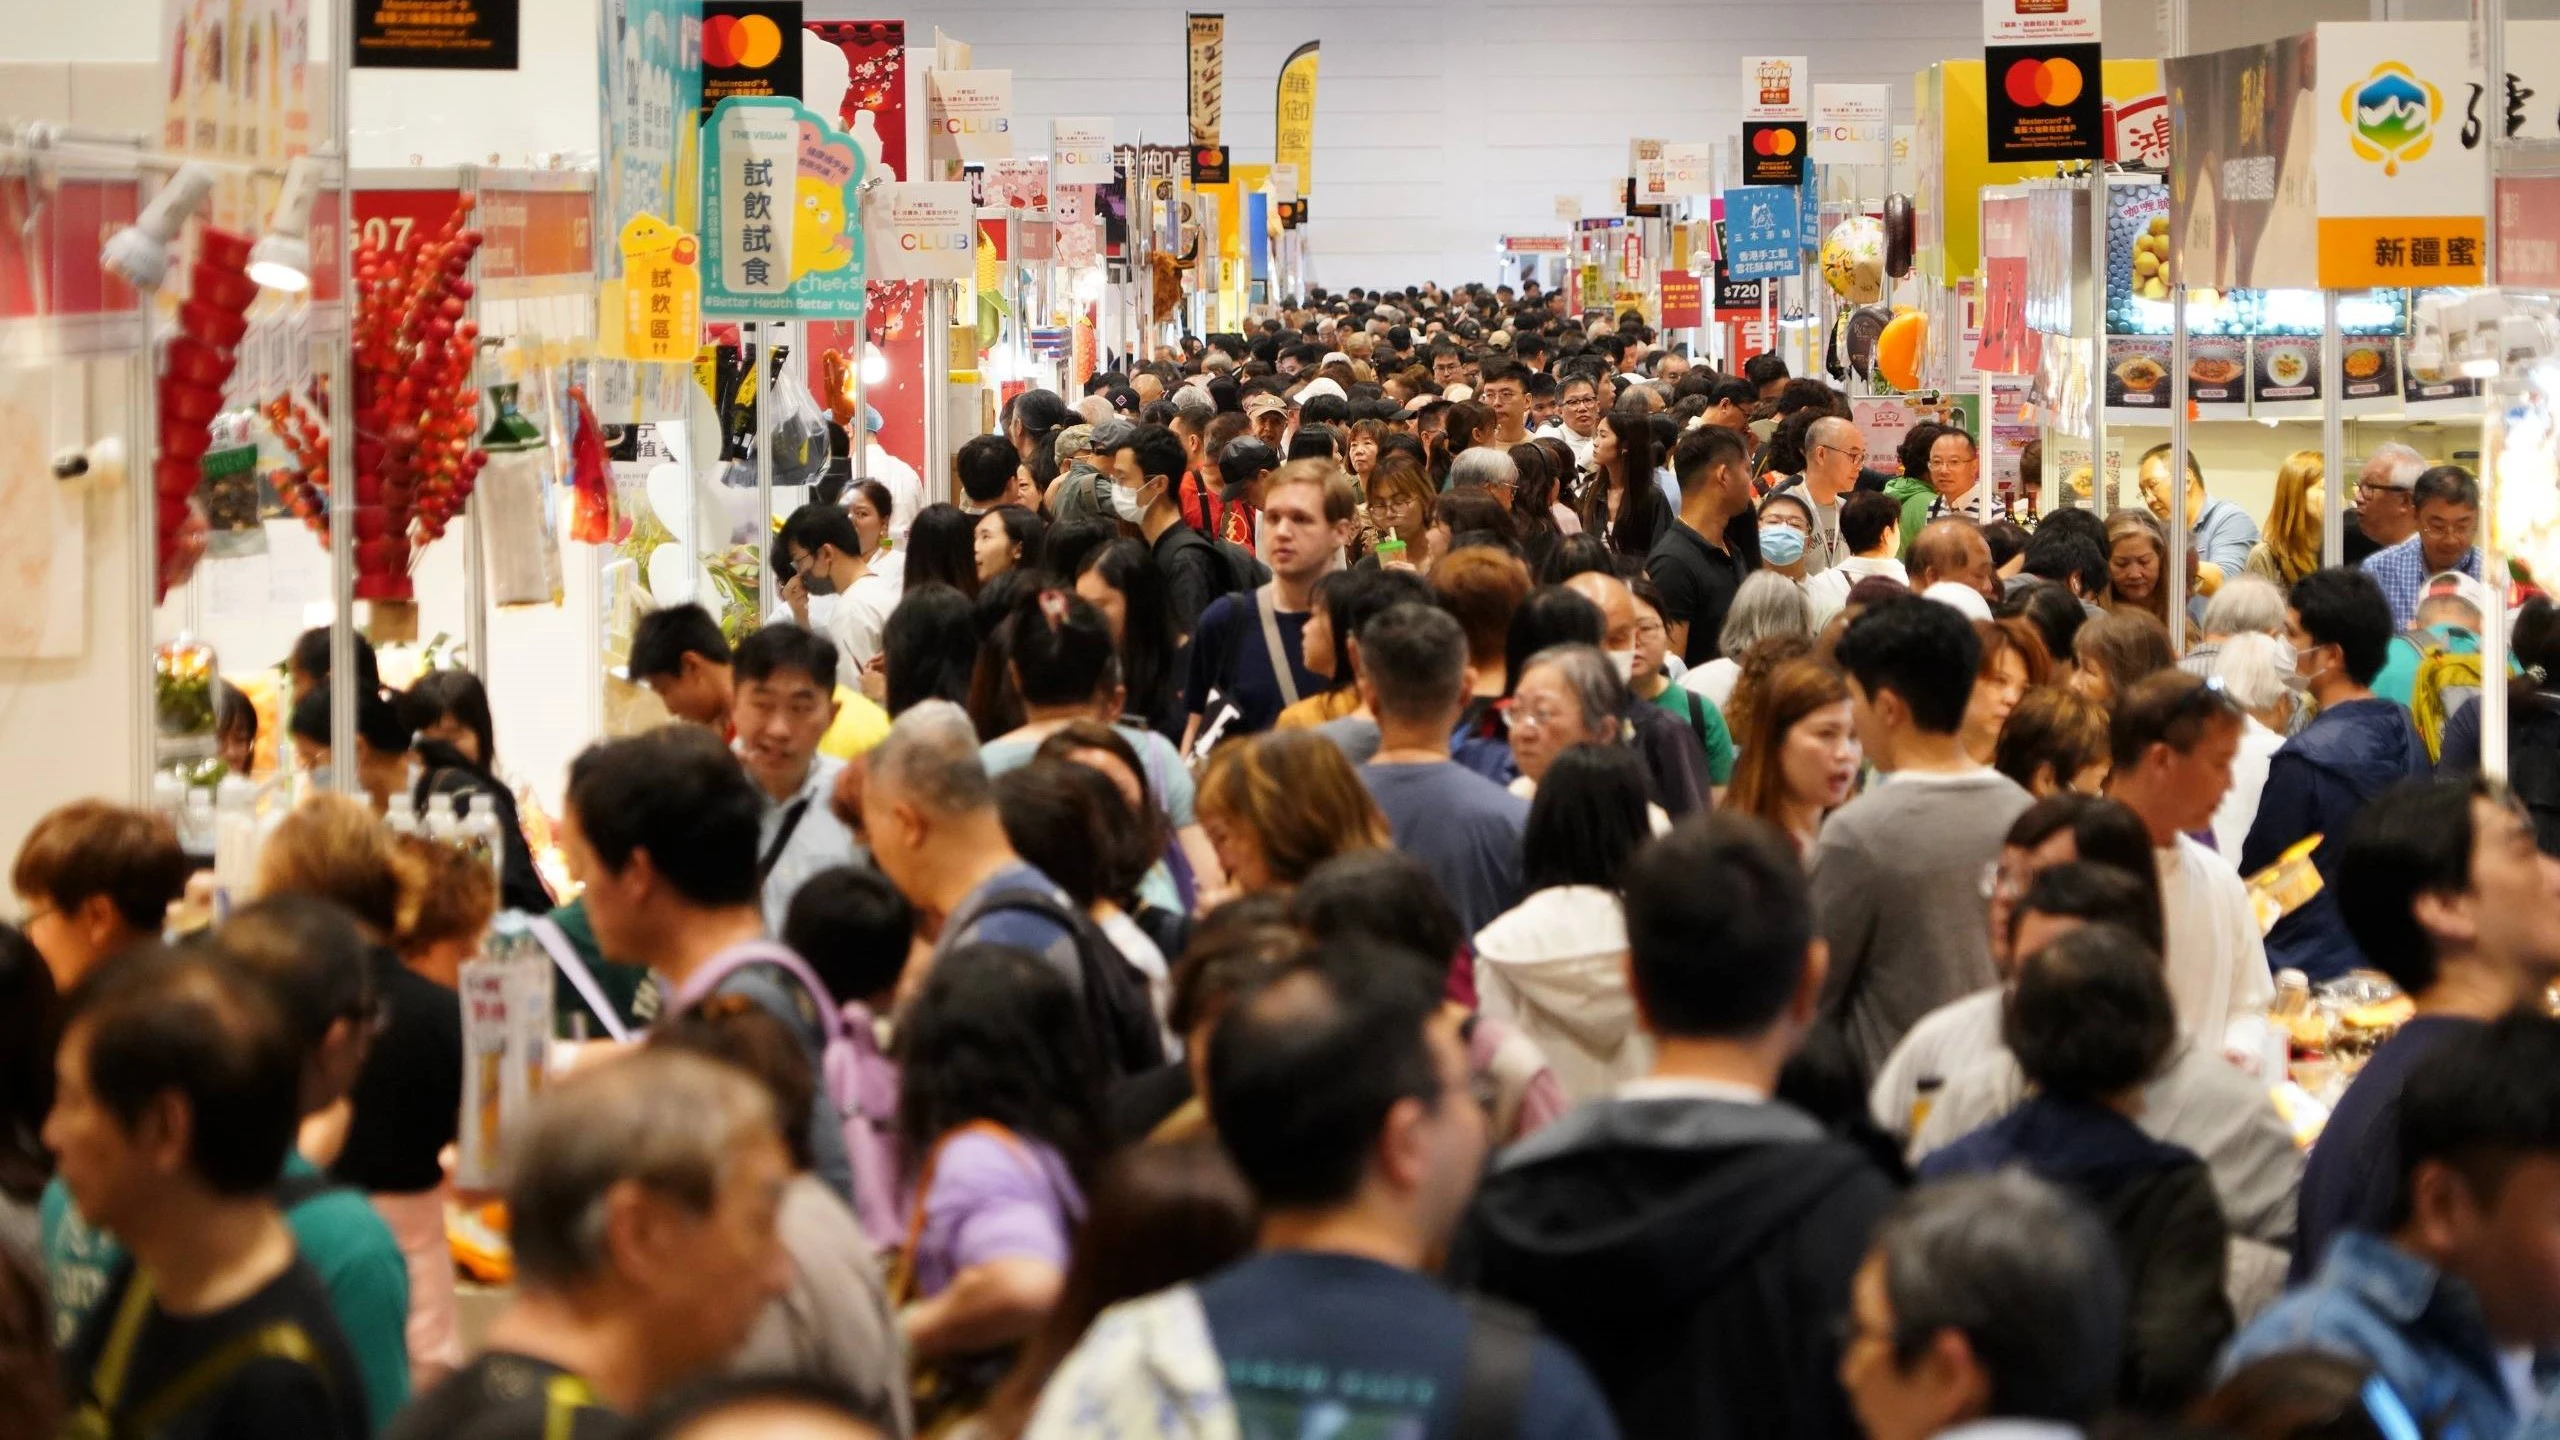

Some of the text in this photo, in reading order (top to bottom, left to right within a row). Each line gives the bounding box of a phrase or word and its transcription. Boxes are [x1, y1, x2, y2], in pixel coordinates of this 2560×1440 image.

[946, 118, 1009, 134] CLUB
[731, 131, 788, 140] THE VEGAN
[1066, 152, 1112, 165] CLUB
[742, 158, 773, 286] 試飲試食
[901, 233, 968, 250] CLUB
[2374, 235, 2486, 269] 新疆蜜
[1723, 284, 1760, 298] $720
[650, 267, 672, 340] 試飲區
[753, 298, 792, 309] Health
[796, 298, 833, 310] Better
[837, 300, 860, 310] You
